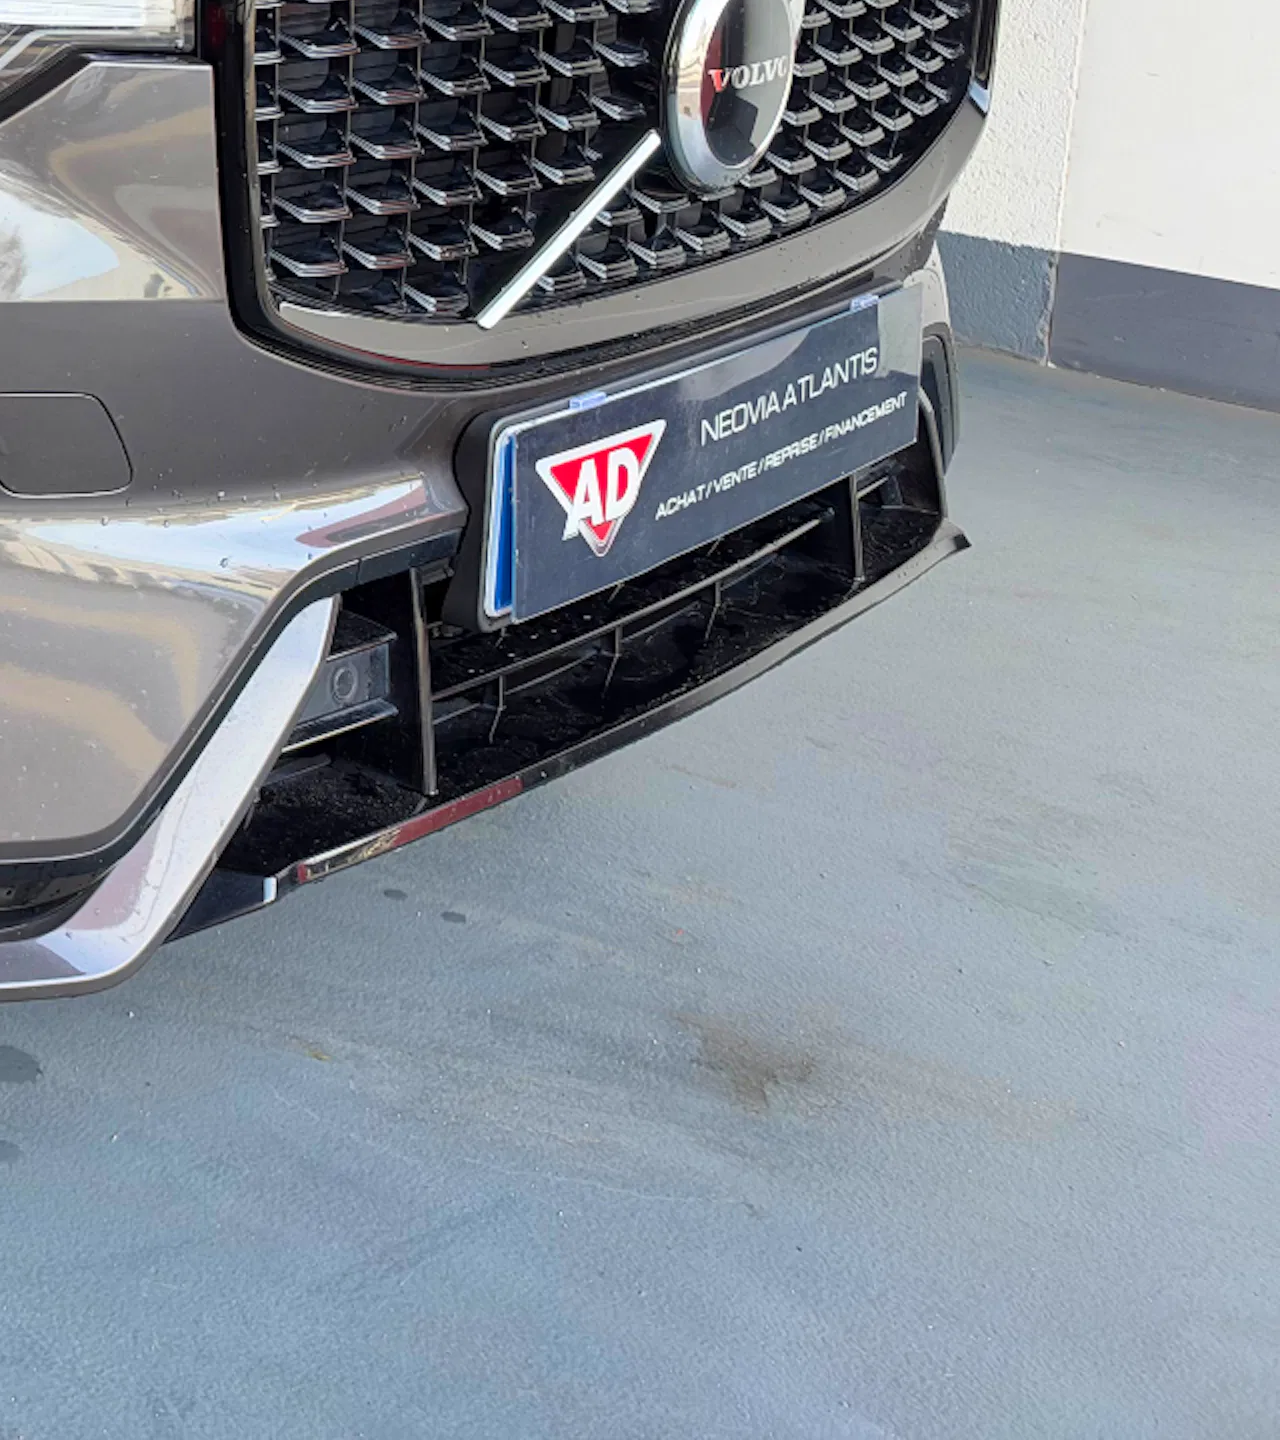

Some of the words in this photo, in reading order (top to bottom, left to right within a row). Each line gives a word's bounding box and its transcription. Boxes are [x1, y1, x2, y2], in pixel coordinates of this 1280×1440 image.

[708, 56, 788, 92] VOLVO
[701, 390, 781, 447] NEOVIA
[781, 346, 878, 411] ATLANTIS
[562, 447, 639, 541] AD
